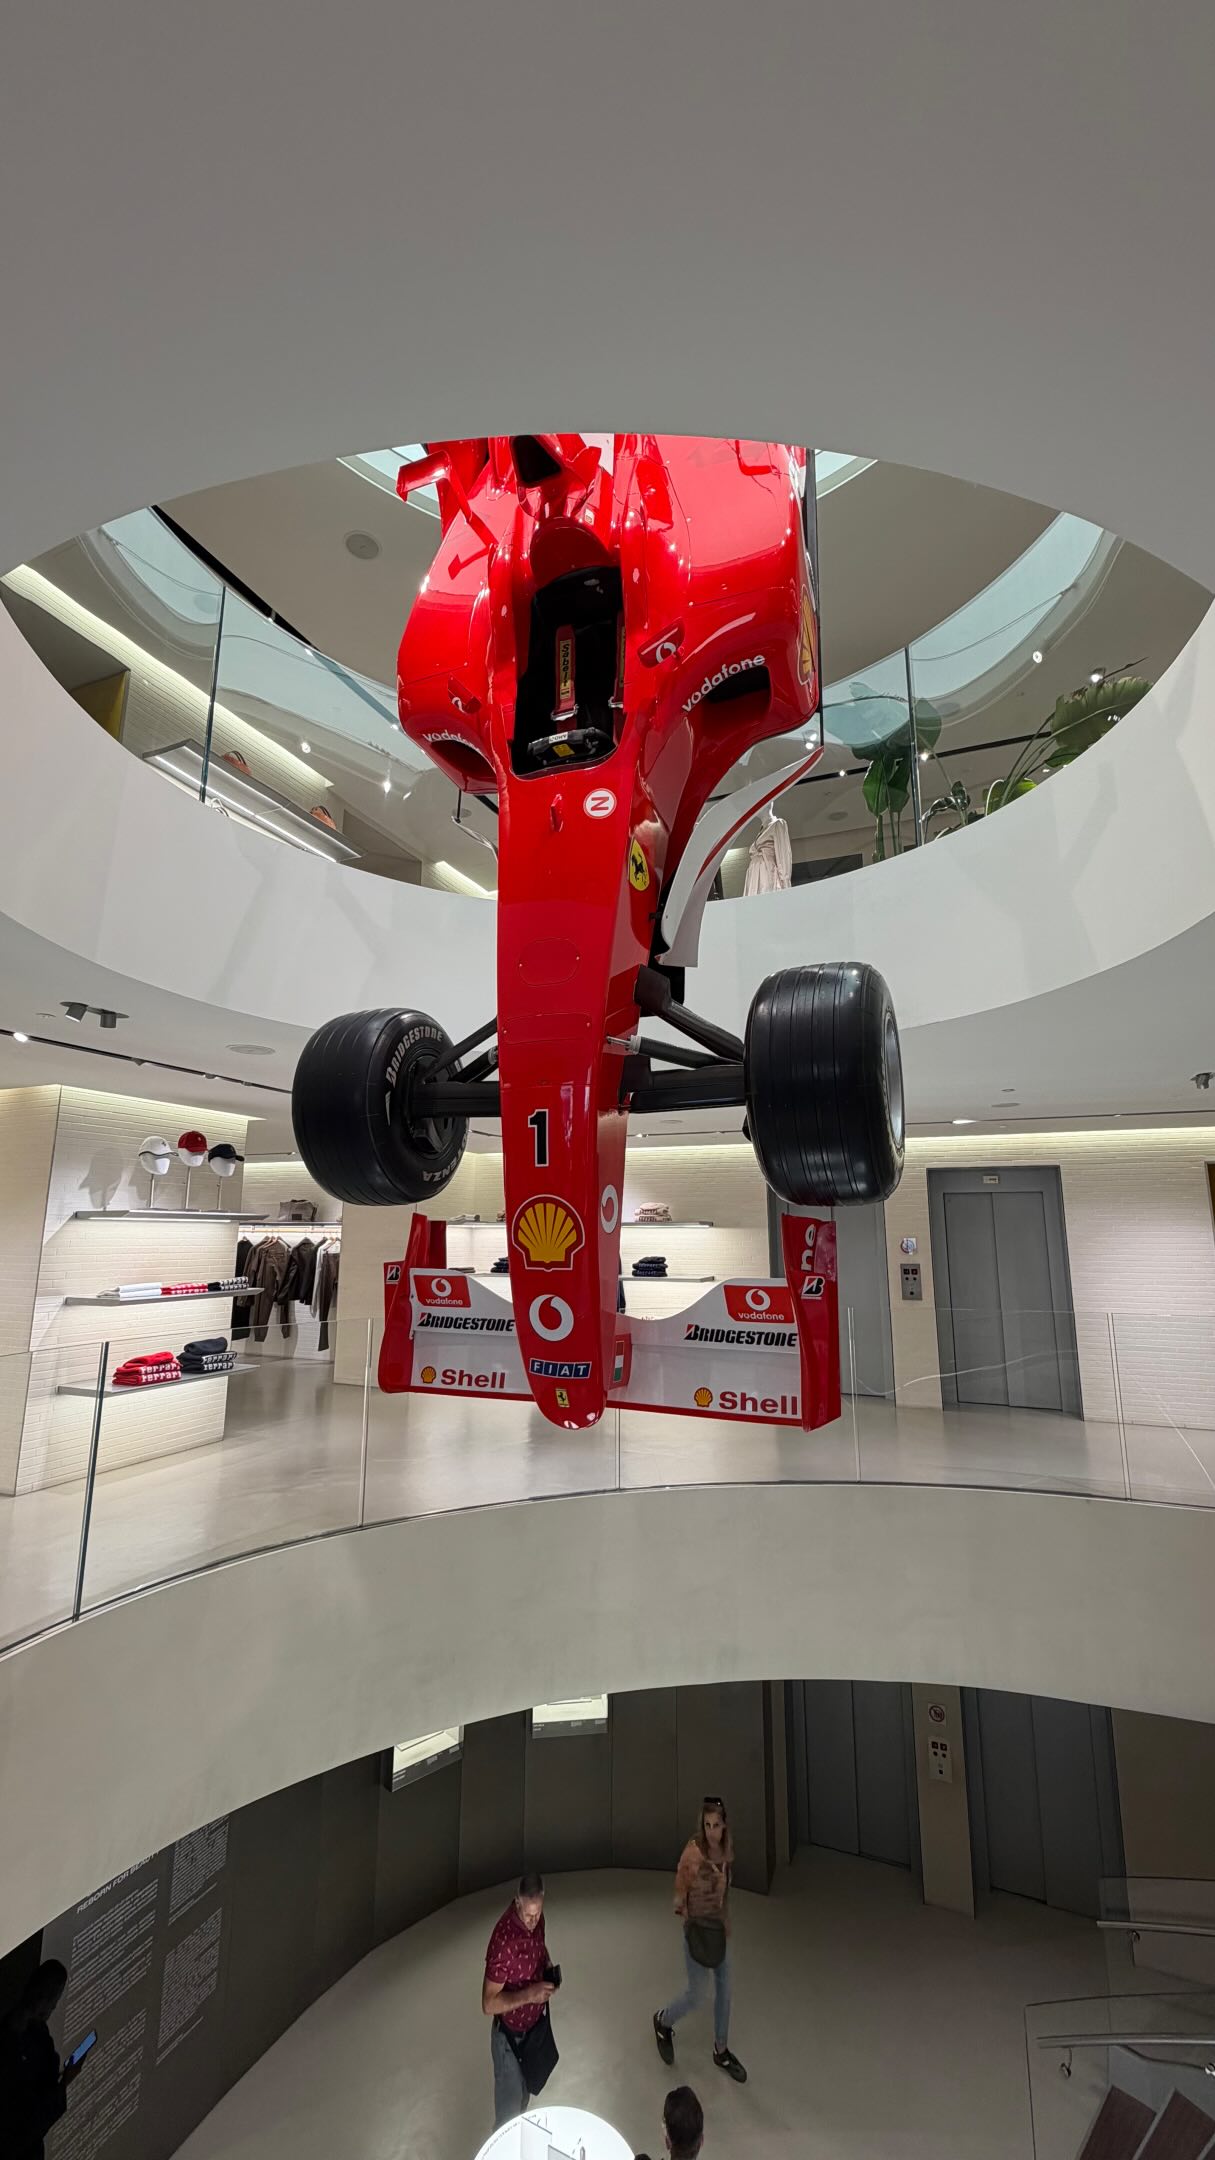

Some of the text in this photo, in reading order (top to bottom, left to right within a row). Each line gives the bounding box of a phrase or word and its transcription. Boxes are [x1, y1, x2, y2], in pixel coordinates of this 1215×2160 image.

[681, 654, 766, 712] vodafone
[386, 1025, 443, 1088] BRIDGESTONE
[528, 1108, 549, 1167] 1
[425, 1297, 463, 1306] vodafone
[417, 1312, 516, 1332] BRIDGESTONE
[737, 1311, 785, 1321] vodafone
[684, 1323, 798, 1348] BRIDGESTONE
[441, 1368, 506, 1389] Shell
[532, 1361, 588, 1377] FIAT
[719, 1391, 798, 1416] Shell
[76, 1883, 113, 1915] REBORN
[112, 1871, 130, 1888] FOR
